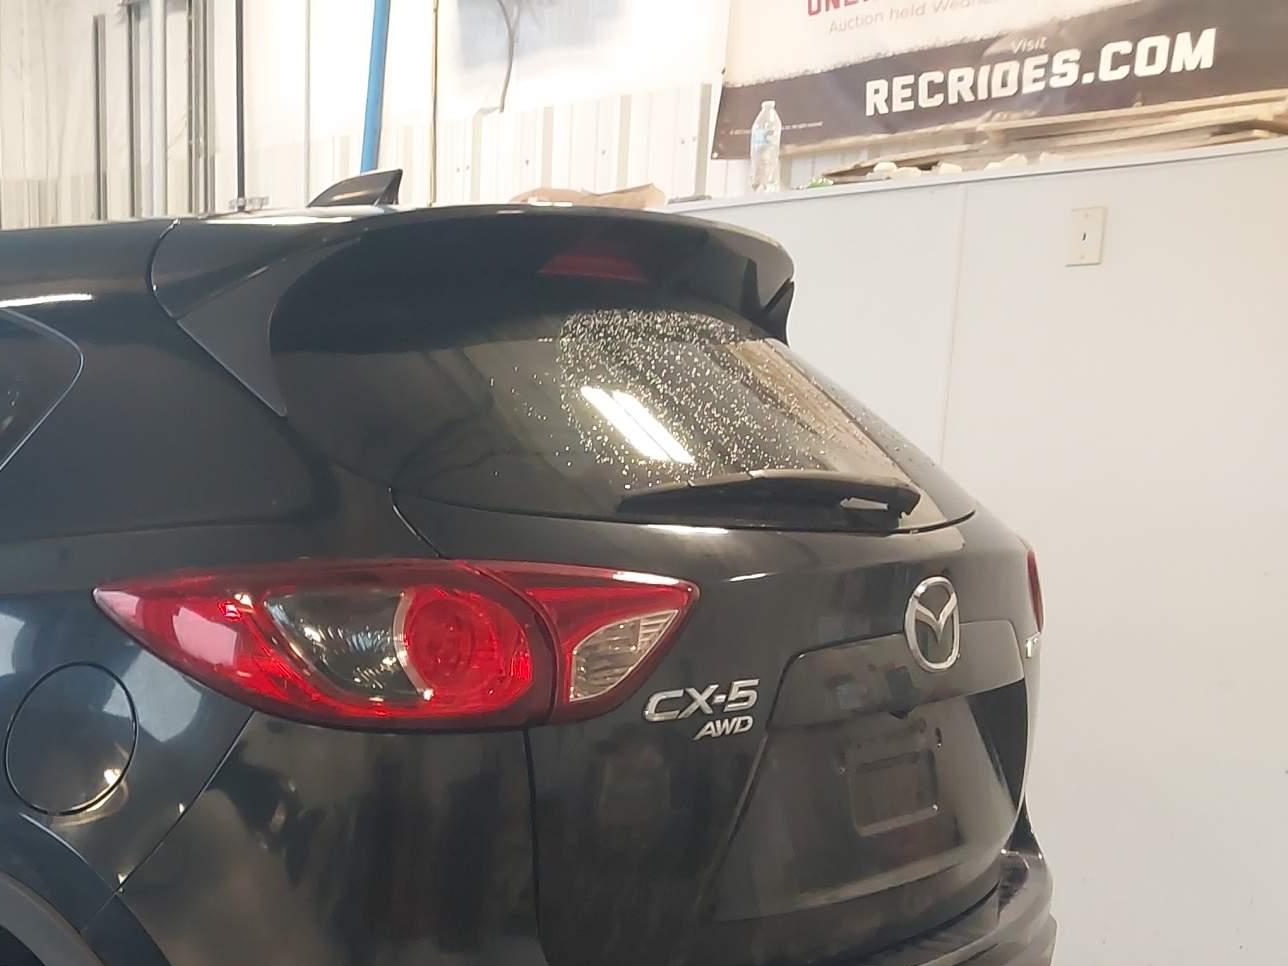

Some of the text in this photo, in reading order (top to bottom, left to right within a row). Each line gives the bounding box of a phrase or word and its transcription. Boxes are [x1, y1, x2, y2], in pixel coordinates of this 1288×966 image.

[828, 12, 884, 35] Auction
[889, 3, 926, 21] held
[1013, 36, 1048, 54] Visit
[865, 28, 1216, 116] RECRIDES.COM
[643, 678, 760, 721] CX-5
[693, 715, 753, 740] AWD
